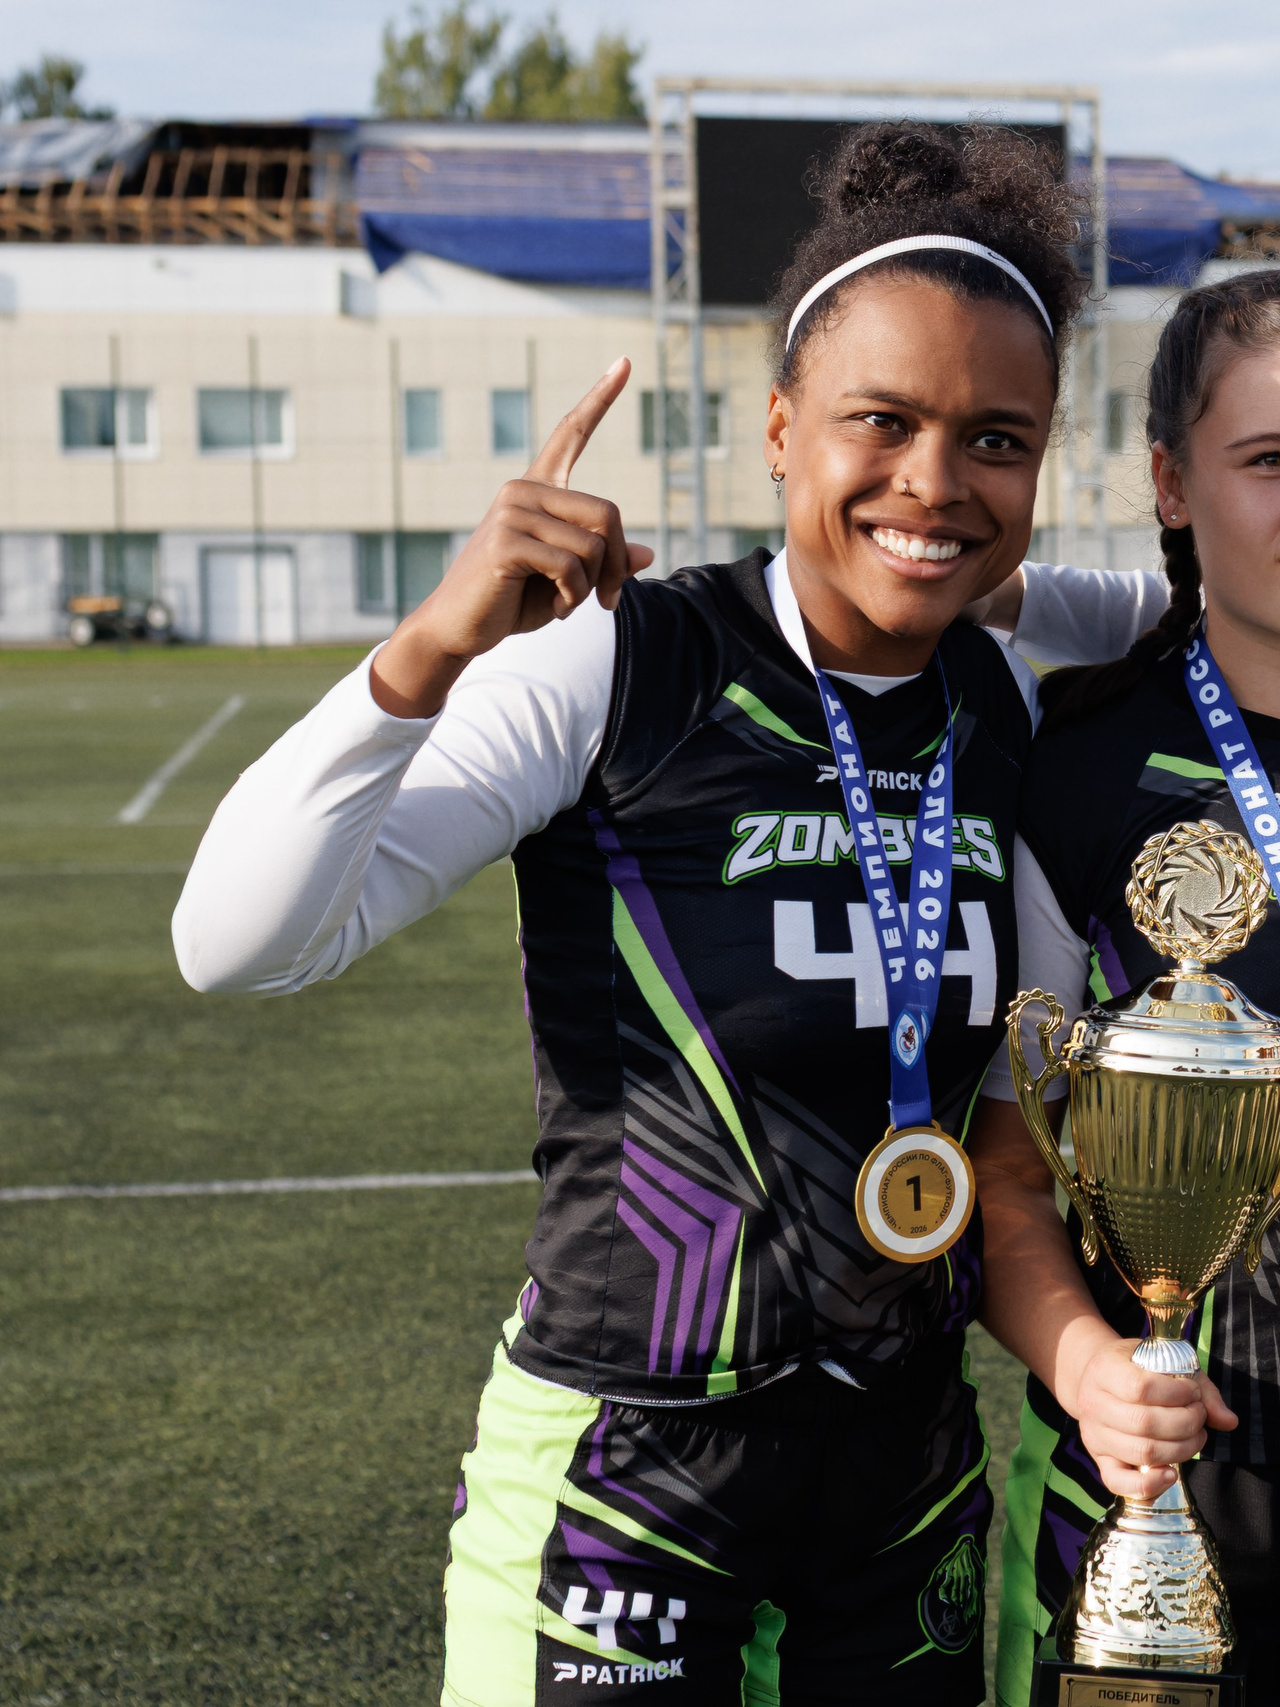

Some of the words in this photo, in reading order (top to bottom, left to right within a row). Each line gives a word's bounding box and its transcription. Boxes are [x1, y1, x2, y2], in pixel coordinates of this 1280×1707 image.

[1185, 639, 1234, 729] РОСС
[866, 769, 923, 791] TRICK
[825, 694, 907, 983] ЧЕМПИОНАТ
[915, 868, 944, 981] 2026
[888, 1153, 918, 1177] РОССИИ
[918, 1153, 930, 1161] ПО
[881, 1176, 897, 1229] ЧЕМПИОНАТ
[906, 1174, 922, 1212] 1
[910, 1225, 928, 1234] 2026
[581, 1657, 685, 1685] PATRICK
[1098, 1689, 1181, 1705] ПОБЕДИТЕЛЬ
